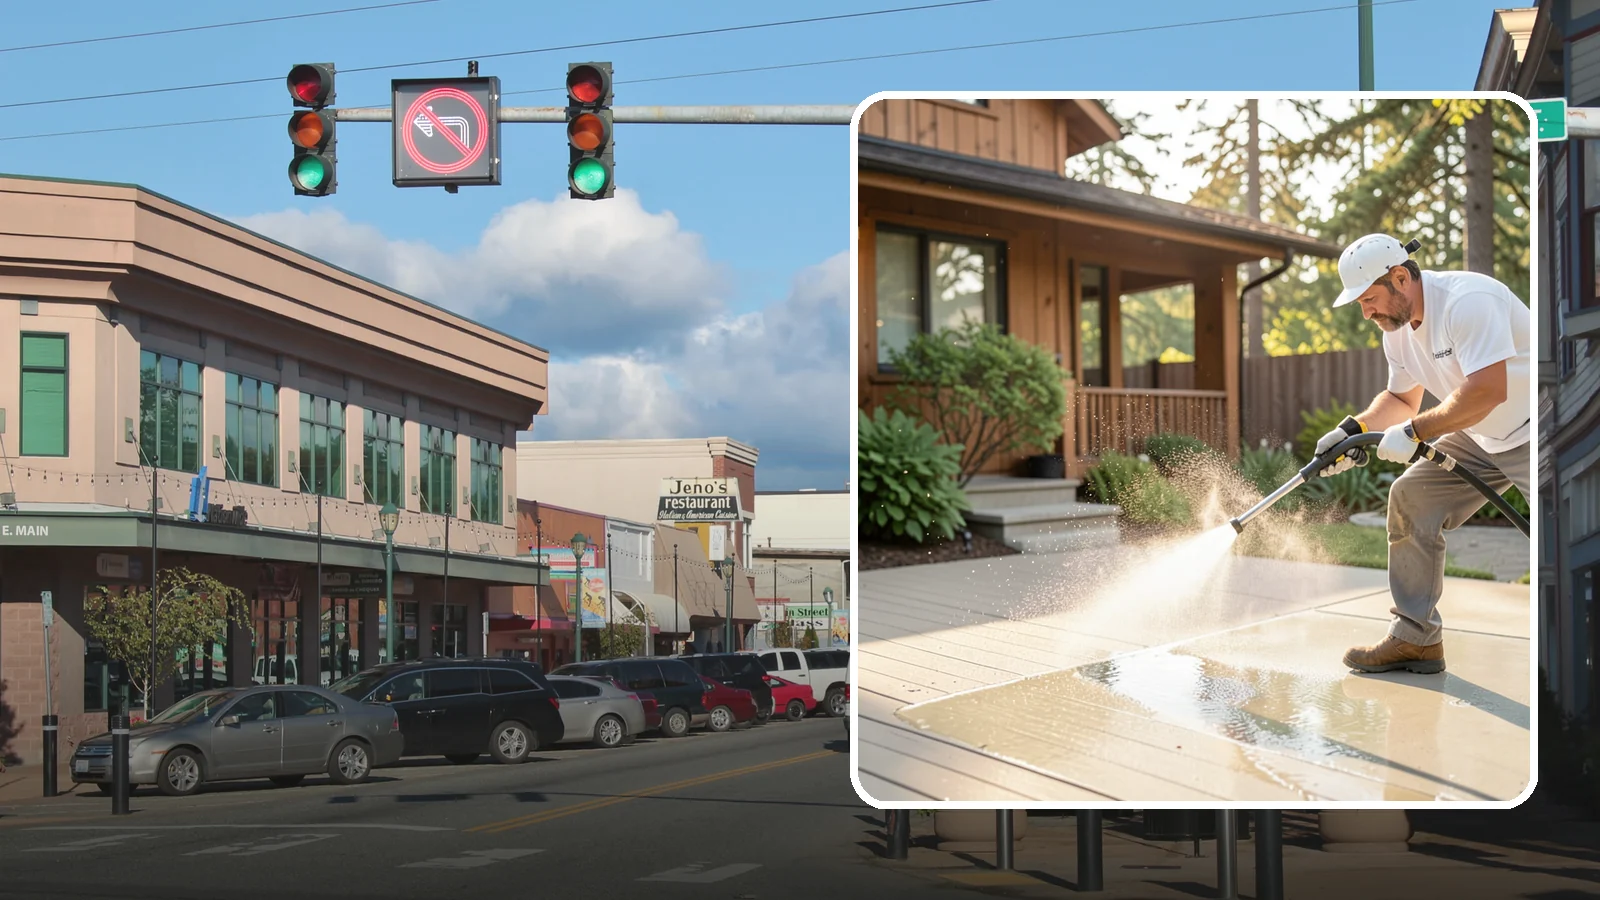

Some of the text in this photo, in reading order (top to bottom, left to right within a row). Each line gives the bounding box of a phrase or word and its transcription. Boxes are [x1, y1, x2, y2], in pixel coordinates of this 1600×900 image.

[669, 479, 728, 494] Jeno's
[665, 496, 731, 509] restaurant
[658, 510, 682, 520] Italian
[686, 510, 715, 519] American
[715, 509, 738, 520] Cuisine
[2, 525, 49, 536] E. MAIN
[785, 607, 829, 617] in Street
[791, 619, 823, 627] lass
